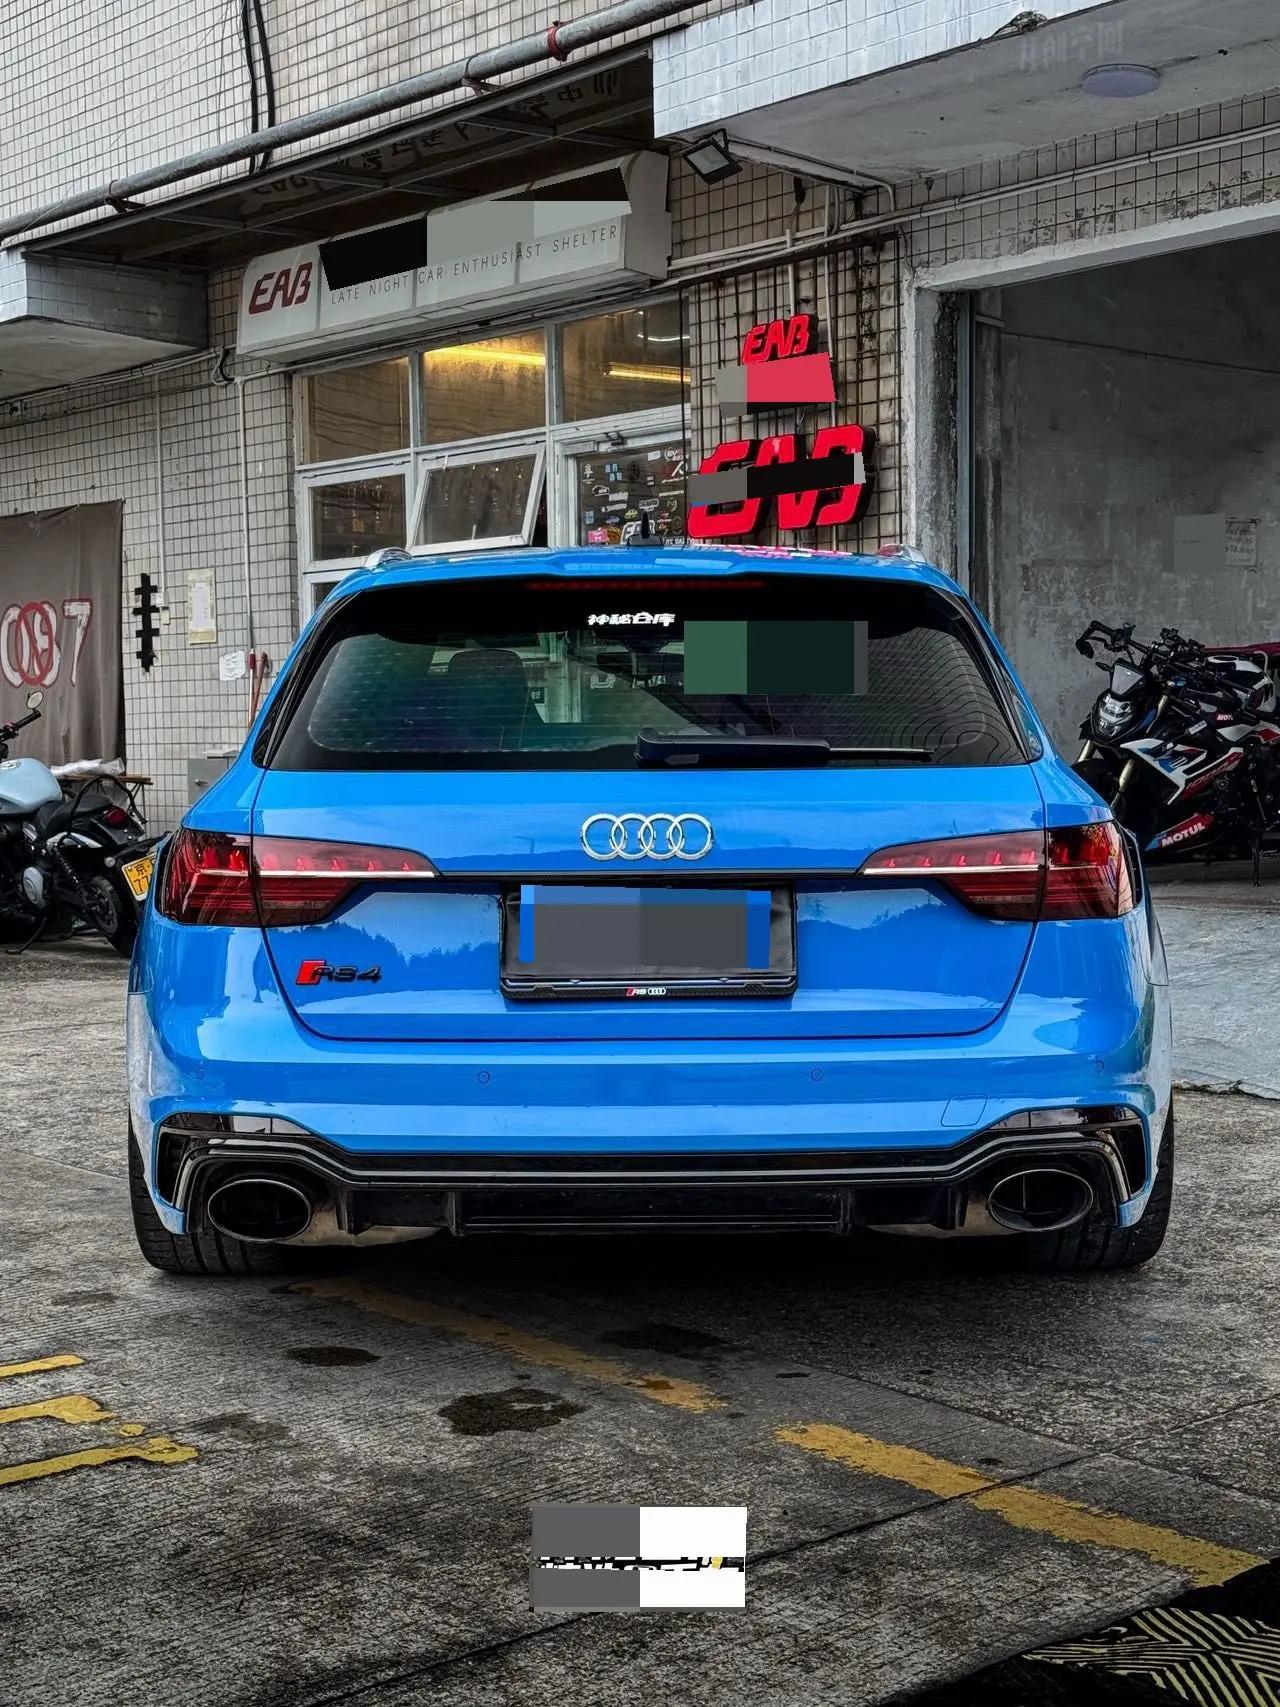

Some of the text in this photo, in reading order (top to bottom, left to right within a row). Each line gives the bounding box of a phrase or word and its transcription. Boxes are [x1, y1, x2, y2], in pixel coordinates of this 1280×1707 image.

[248, 261, 313, 315] EAB
[331, 224, 618, 305] LATE NIGHT CAR ENTHUSIAST SHELTER
[1161, 822, 1206, 847] MOTUL
